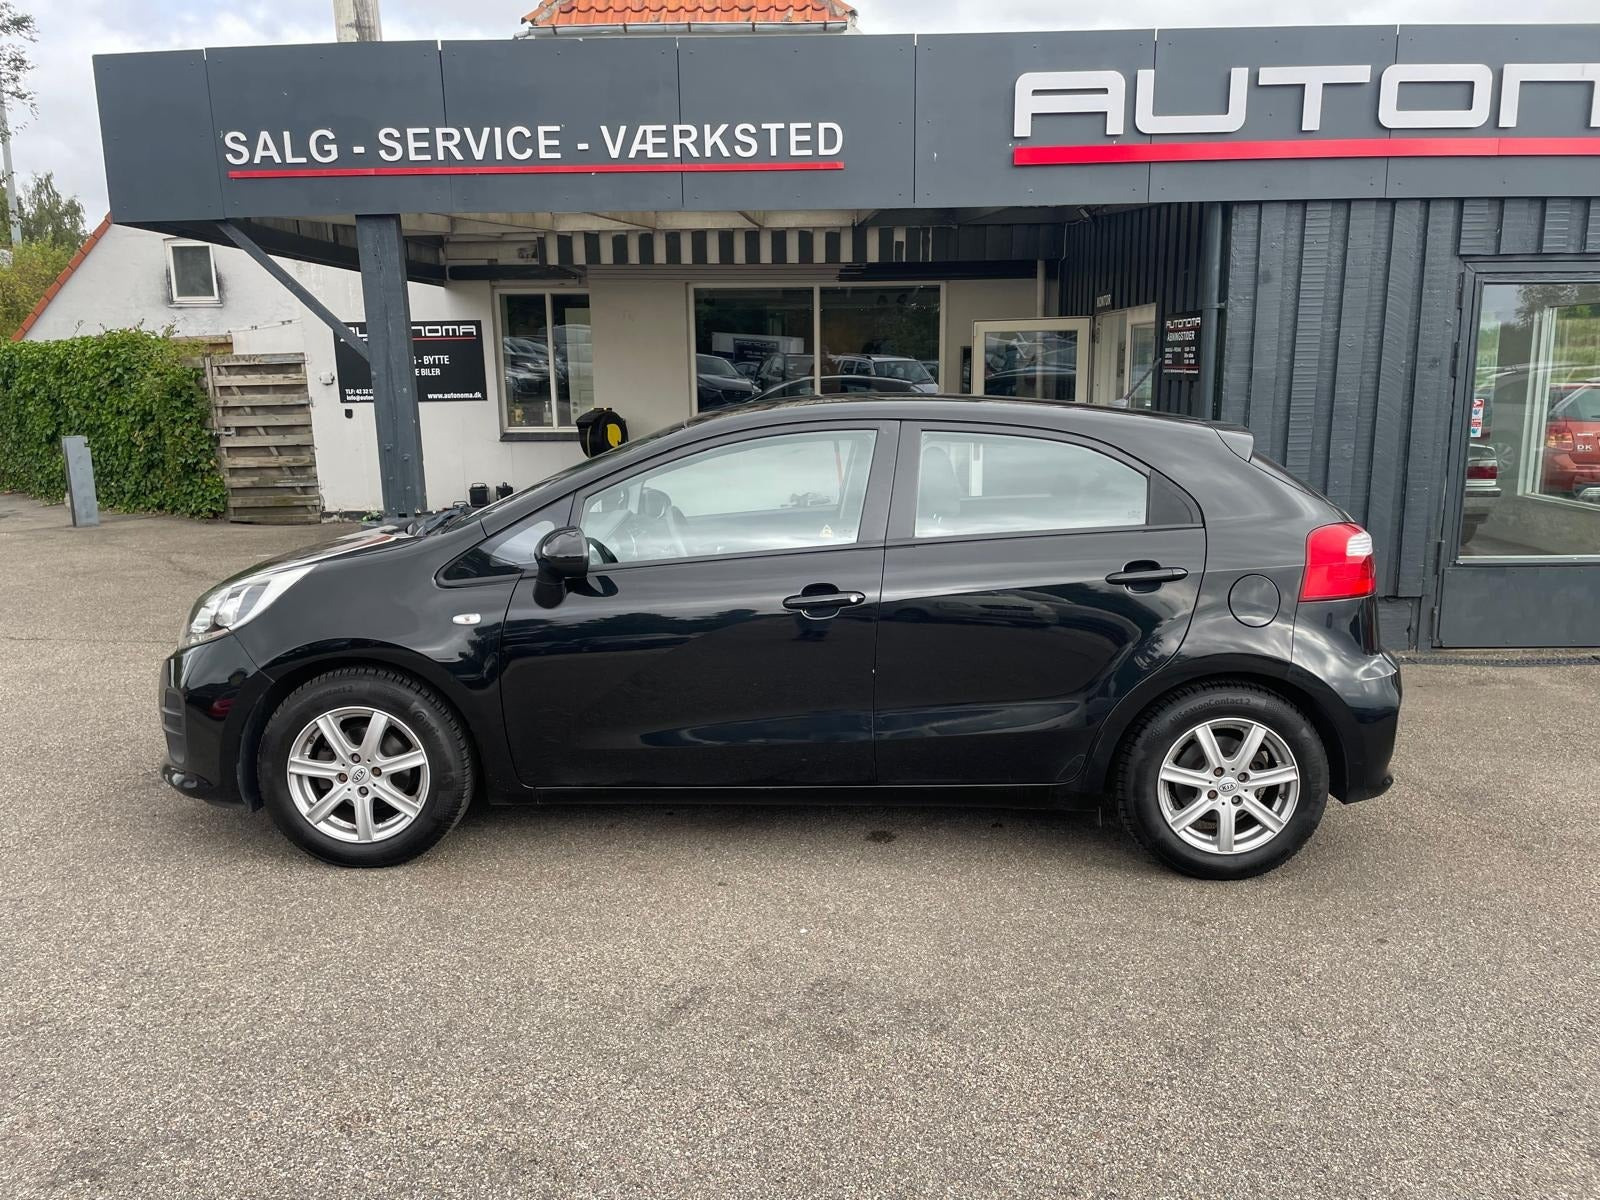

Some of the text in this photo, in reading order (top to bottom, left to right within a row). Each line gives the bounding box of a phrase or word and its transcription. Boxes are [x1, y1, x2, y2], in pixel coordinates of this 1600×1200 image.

[224, 122, 843, 165] SALG - SERVICE - VÆRKSTED
[423, 355, 450, 365] BYTTE
[420, 368, 440, 376] BILER
